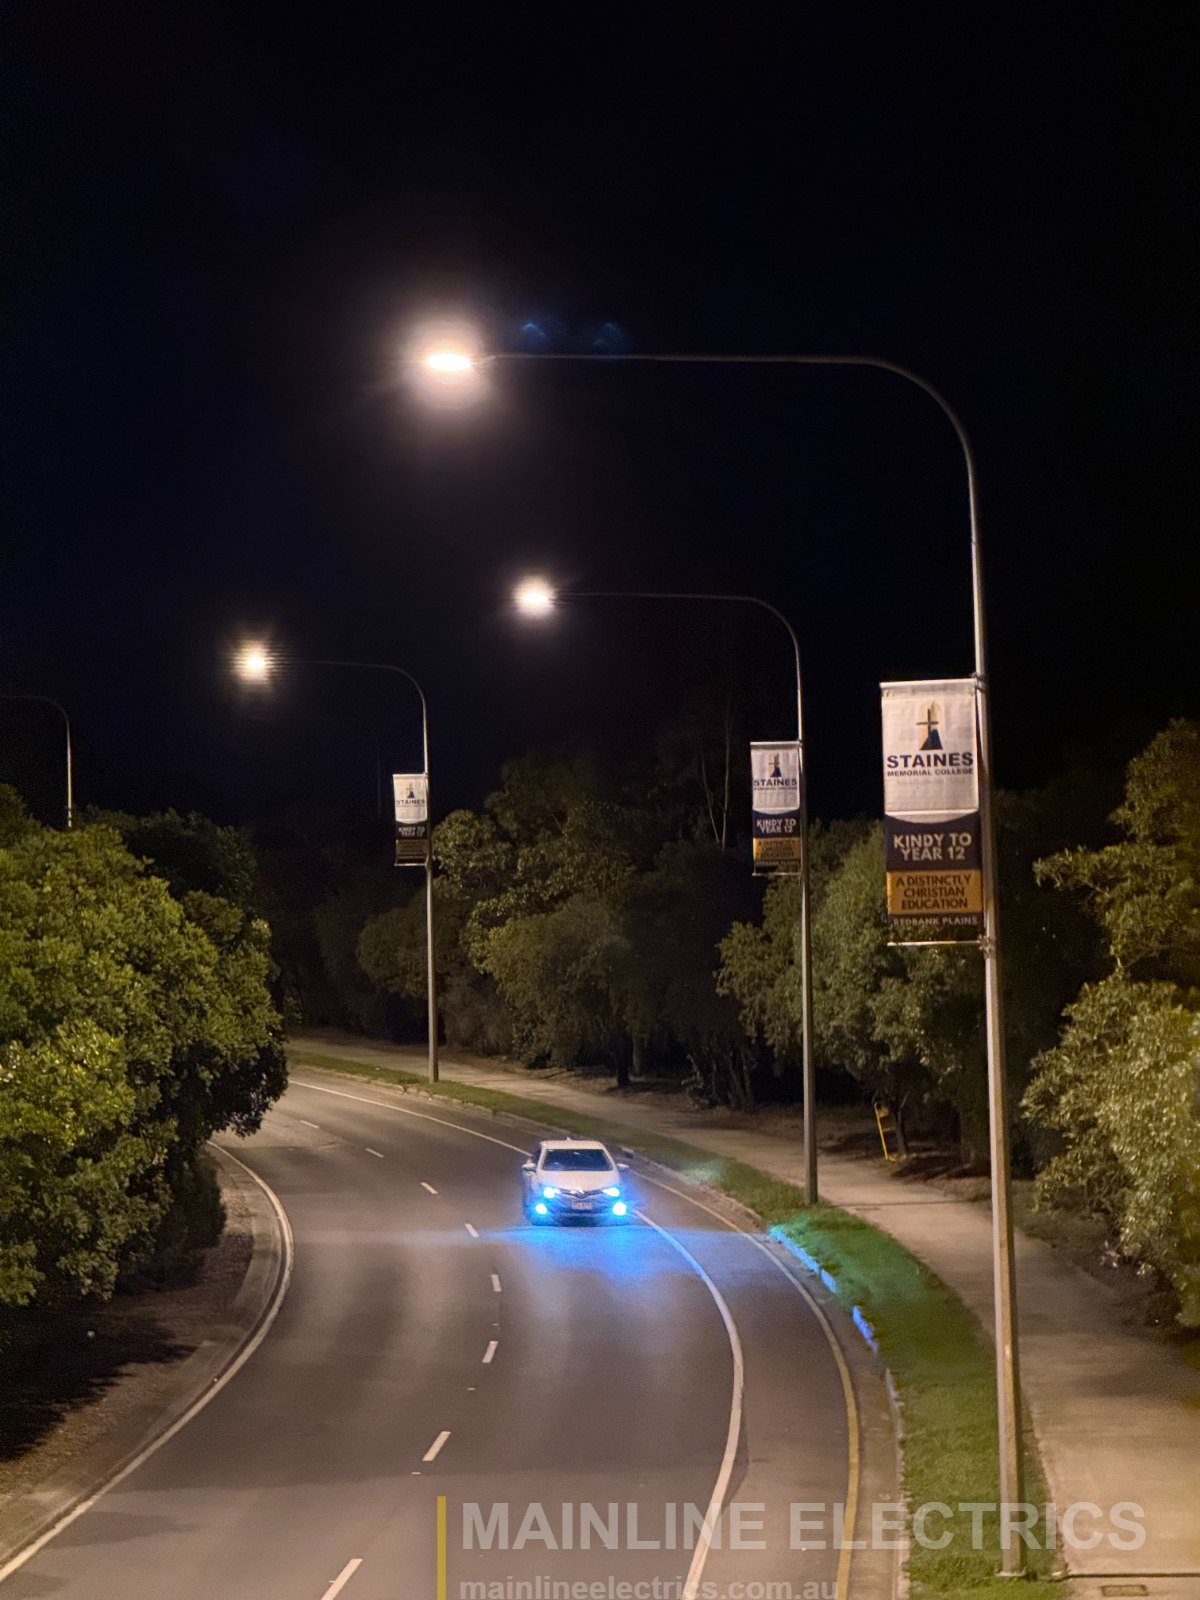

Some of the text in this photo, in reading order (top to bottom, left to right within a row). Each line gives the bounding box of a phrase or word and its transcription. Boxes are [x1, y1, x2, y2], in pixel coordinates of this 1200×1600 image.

[886, 752, 974, 769] STAINES
[887, 767, 974, 777] MEMORIAL COLLEGE
[753, 778, 797, 786] STAINES
[756, 818, 797, 827] KINDY TO
[893, 832, 972, 849] KINDY TO
[901, 847, 966, 861] YEAR 12
[896, 873, 972, 887] A DISTINCTLY
[903, 886, 965, 898] CHRISTIAN
[901, 898, 968, 910] EDUCATION
[942, 916, 977, 925] PLAINS
